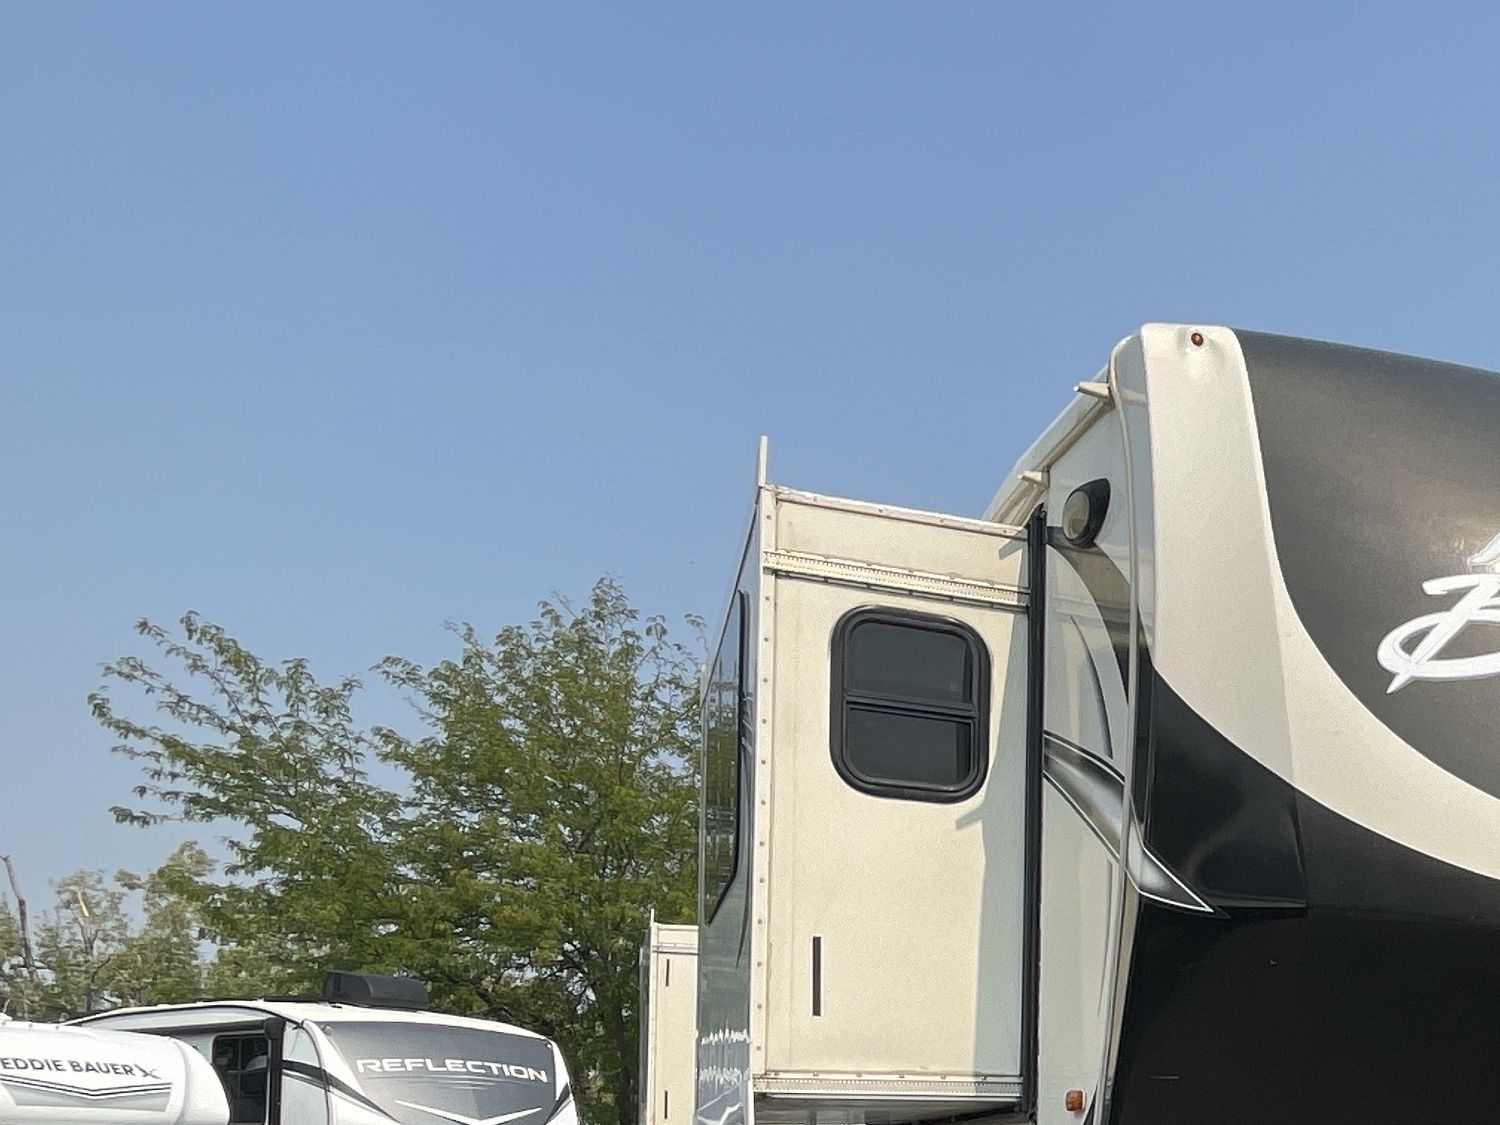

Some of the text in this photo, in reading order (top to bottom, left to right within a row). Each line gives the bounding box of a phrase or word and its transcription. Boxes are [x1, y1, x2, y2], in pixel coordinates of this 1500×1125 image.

[0, 1057, 136, 1076] EDDIE BAUER
[356, 1058, 548, 1083] REFLECTION
